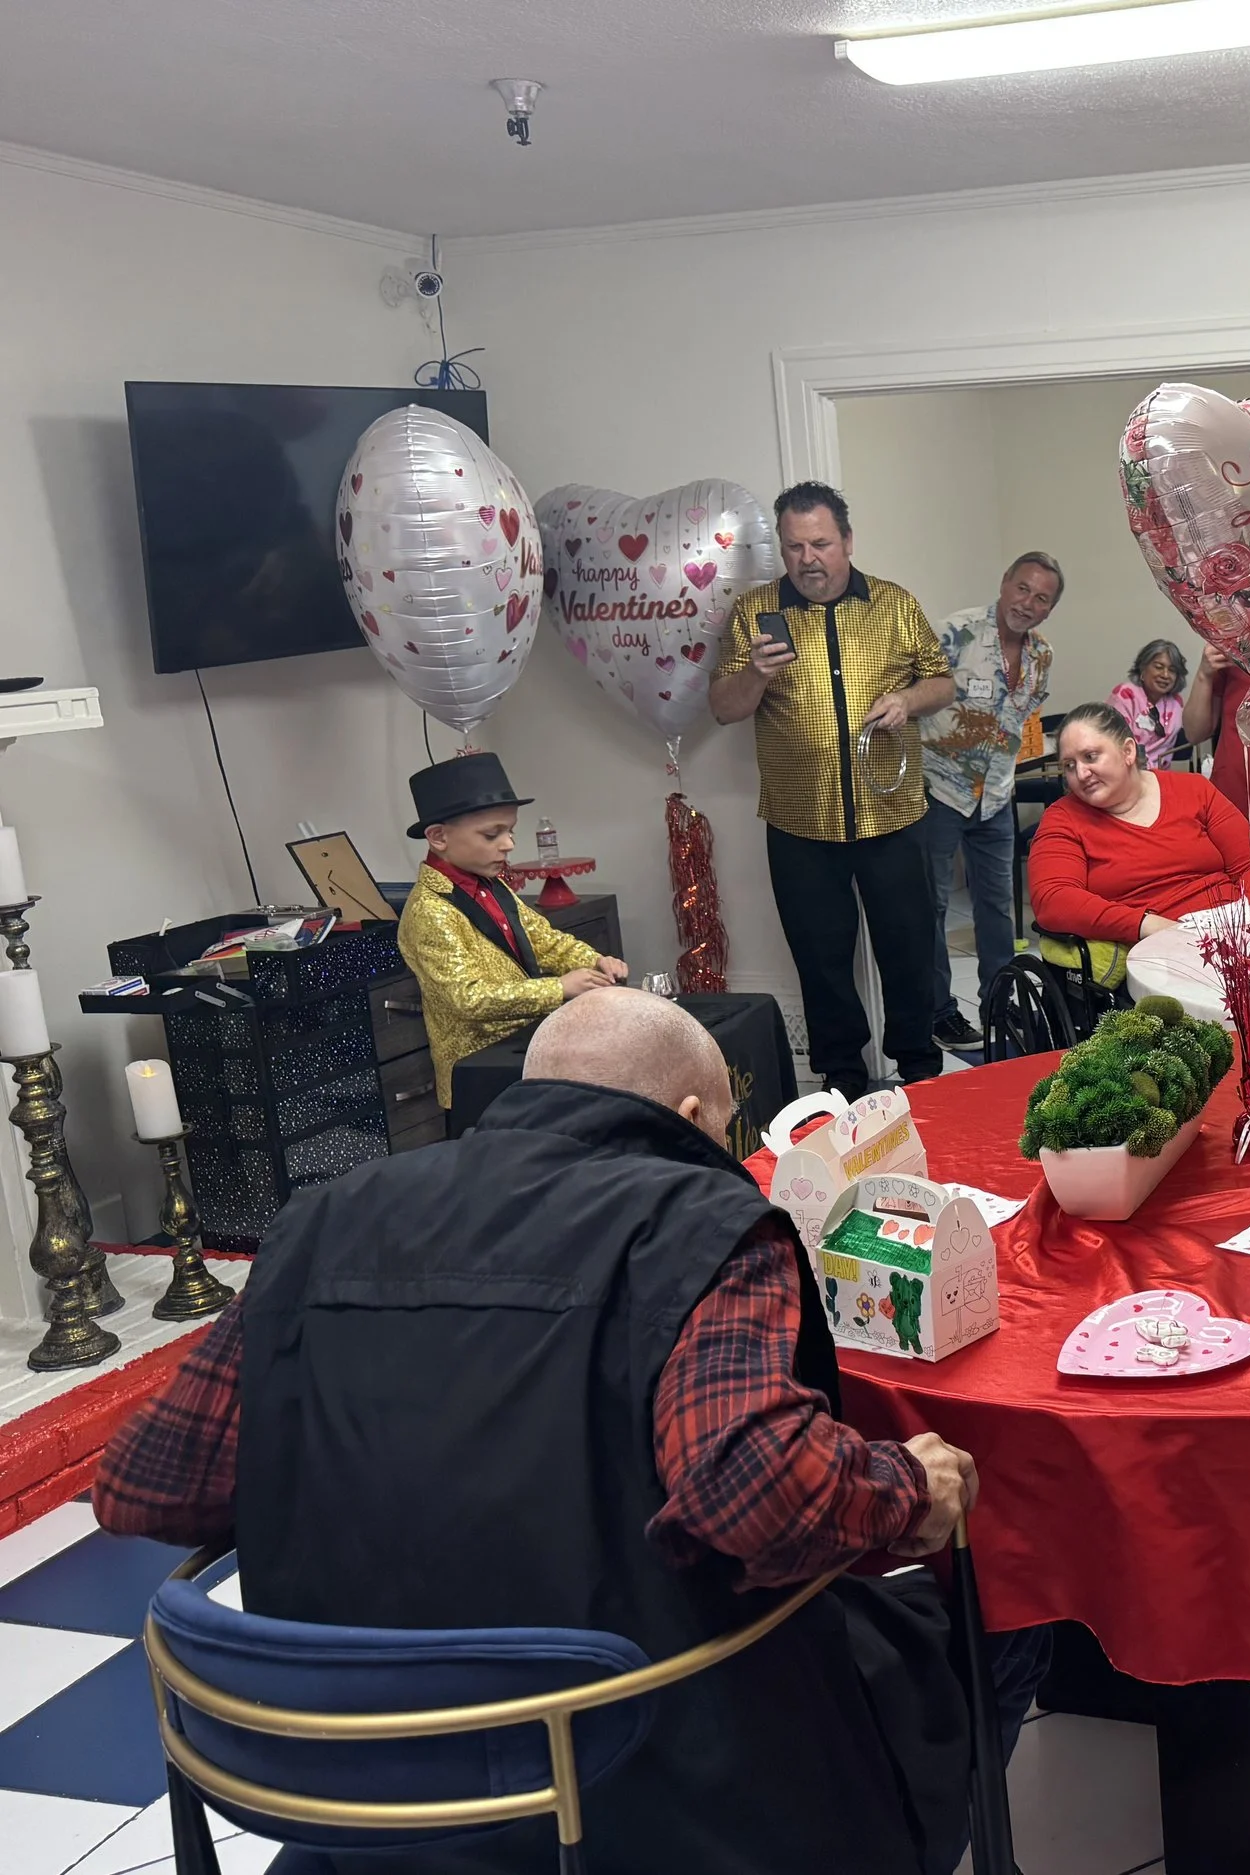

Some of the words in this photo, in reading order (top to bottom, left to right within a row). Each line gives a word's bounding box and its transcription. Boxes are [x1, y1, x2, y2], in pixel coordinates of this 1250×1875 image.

[572, 558, 640, 592] happy
[559, 585, 698, 625] Valentine's
[611, 625, 651, 656] day
[823, 1254, 858, 1283] DAY!
